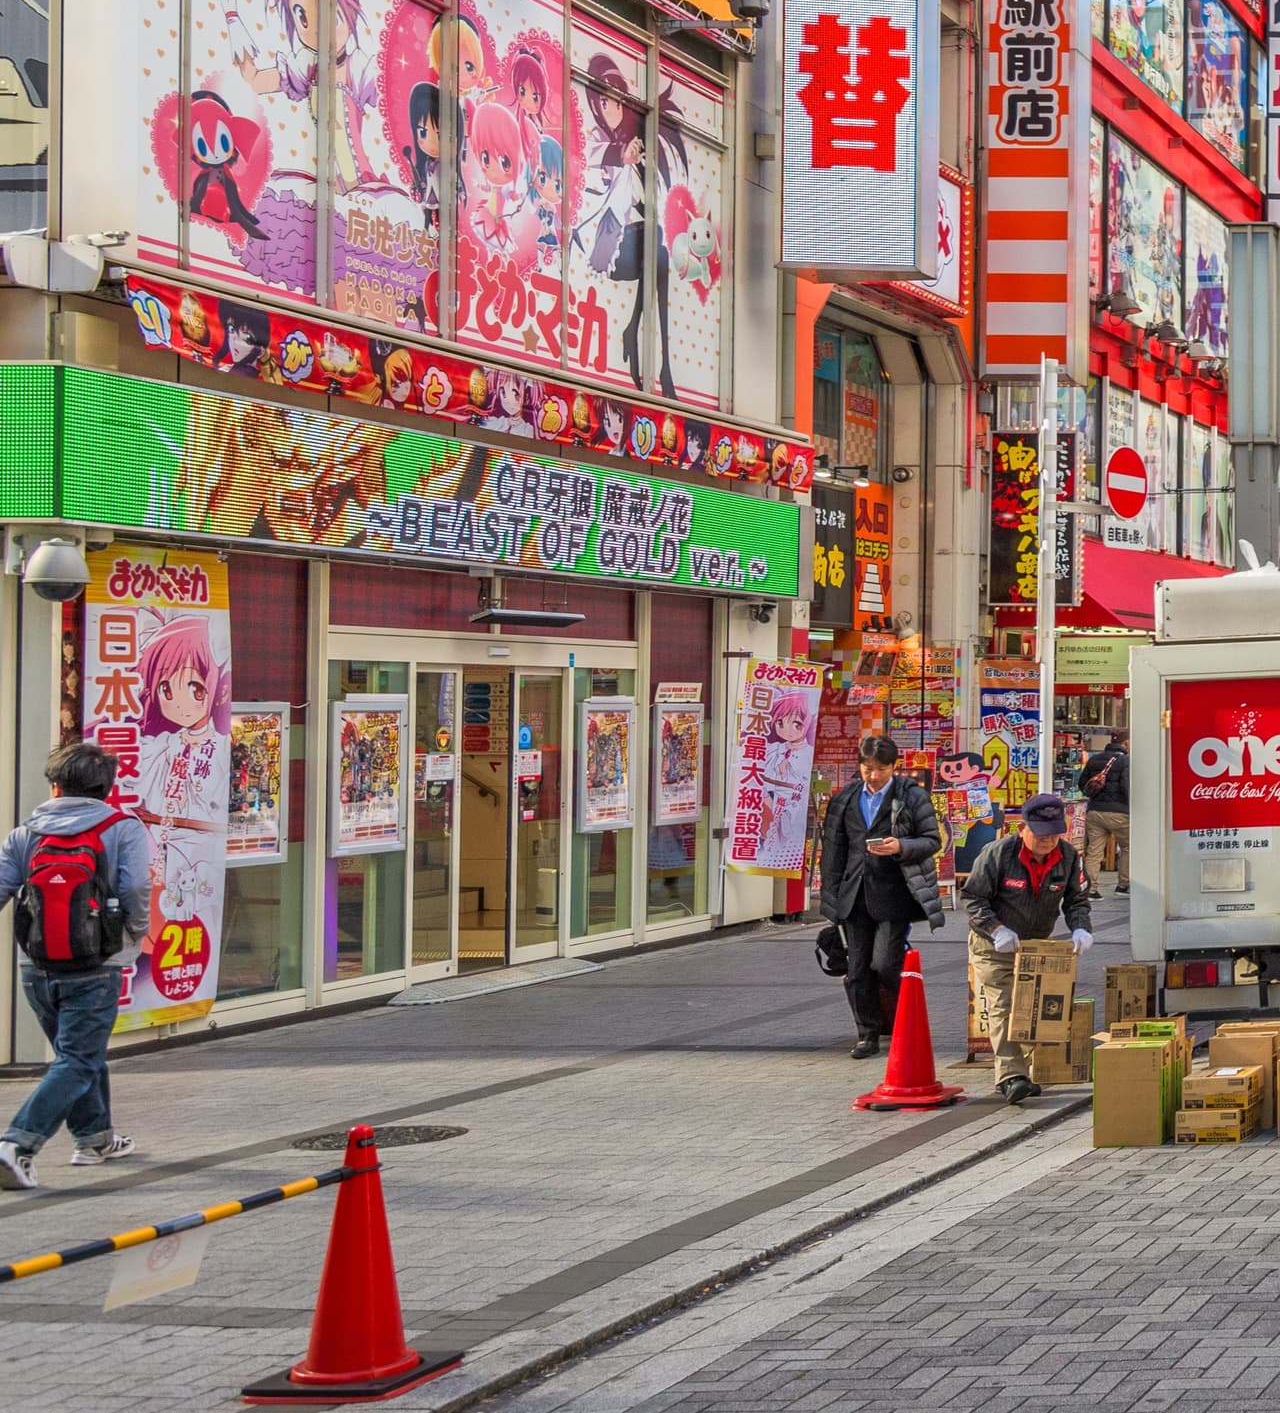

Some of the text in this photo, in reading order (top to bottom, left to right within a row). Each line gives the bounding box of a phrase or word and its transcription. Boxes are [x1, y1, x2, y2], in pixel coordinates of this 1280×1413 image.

[345, 271, 419, 304] MADOKA
[345, 292, 419, 323] MAGICA
[856, 497, 889, 535] 入口
[541, 522, 586, 569] OF
[597, 528, 681, 580] GOLD
[855, 537, 890, 561] はコチラ
[731, 687, 774, 863] 日本最大級設置
[1239, 781, 1266, 799] East
[1197, 838, 1270, 851] 歩行者優先 停止線
[159, 923, 204, 968] 2階
